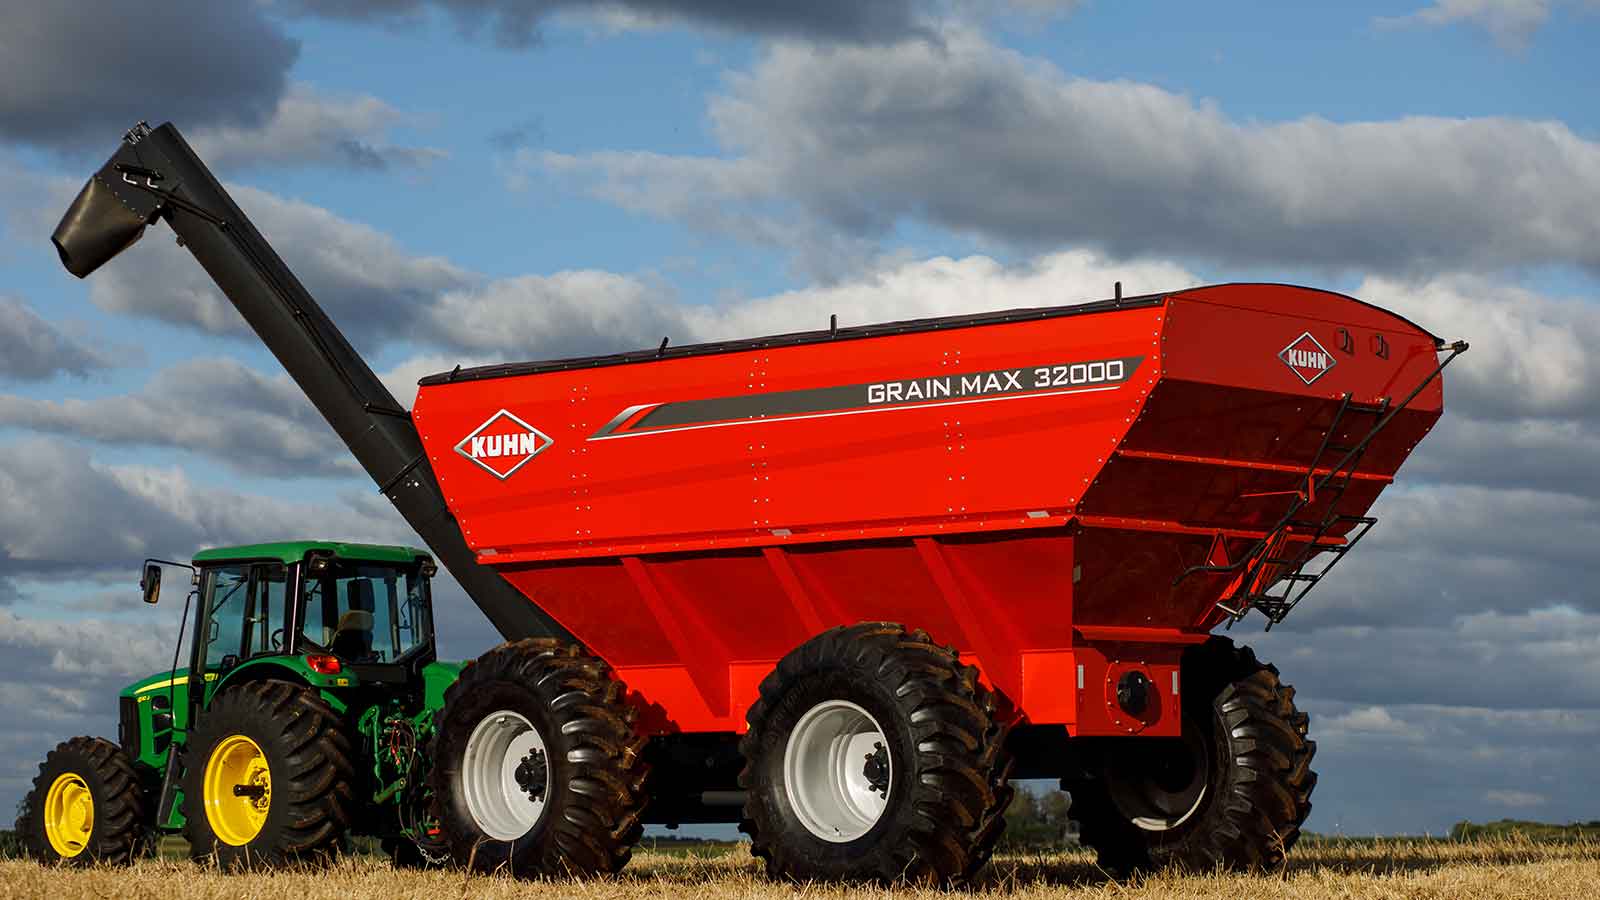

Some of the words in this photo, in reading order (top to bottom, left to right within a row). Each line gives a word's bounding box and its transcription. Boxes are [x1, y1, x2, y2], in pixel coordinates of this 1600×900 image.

[1288, 349, 1327, 369] KUHN
[867, 377, 951, 404] GRAIN
[961, 370, 1023, 396] MAX
[1034, 360, 1124, 388] 32000
[471, 432, 535, 458] KUHN
